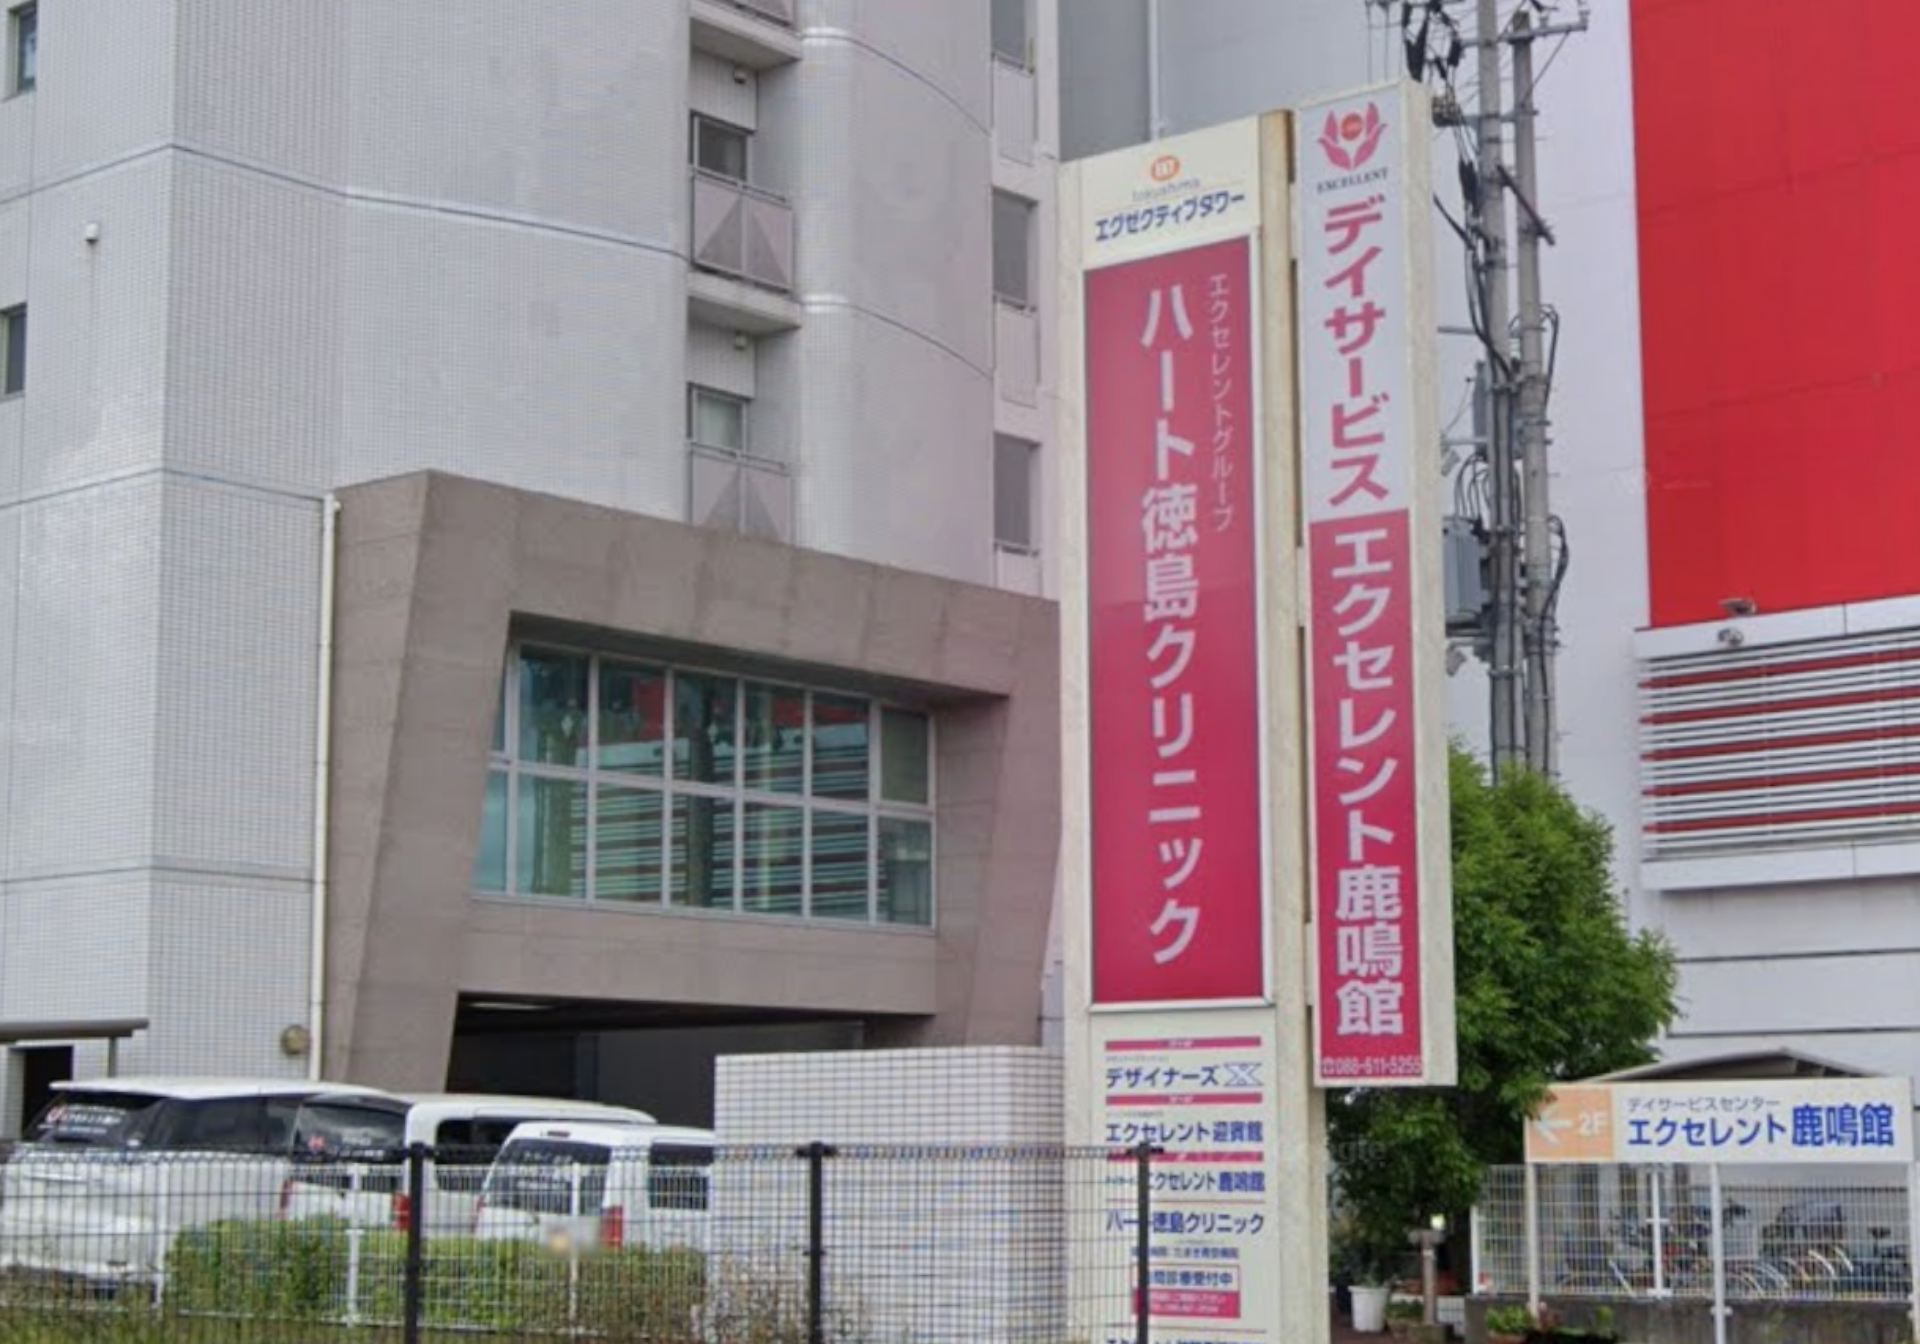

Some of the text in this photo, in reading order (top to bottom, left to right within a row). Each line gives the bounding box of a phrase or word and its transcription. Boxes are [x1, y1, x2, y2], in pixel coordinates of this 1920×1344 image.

[1317, 167, 1388, 194] EXCELLENT
[1324, 193, 1390, 507] デイサービス
[1208, 273, 1234, 532] エクセレントグループ
[1140, 284, 1203, 965] ハート徳島クリニック
[1332, 528, 1404, 1036] エクセレント鹿鳴館
[1579, 1110, 1608, 1137] 2F
[1628, 1096, 1781, 1112] デイサービスセンター
[1628, 1103, 1894, 1147] エクセレント鹿鳴館
[1106, 1210, 1265, 1234] ハー徳島クリニック
